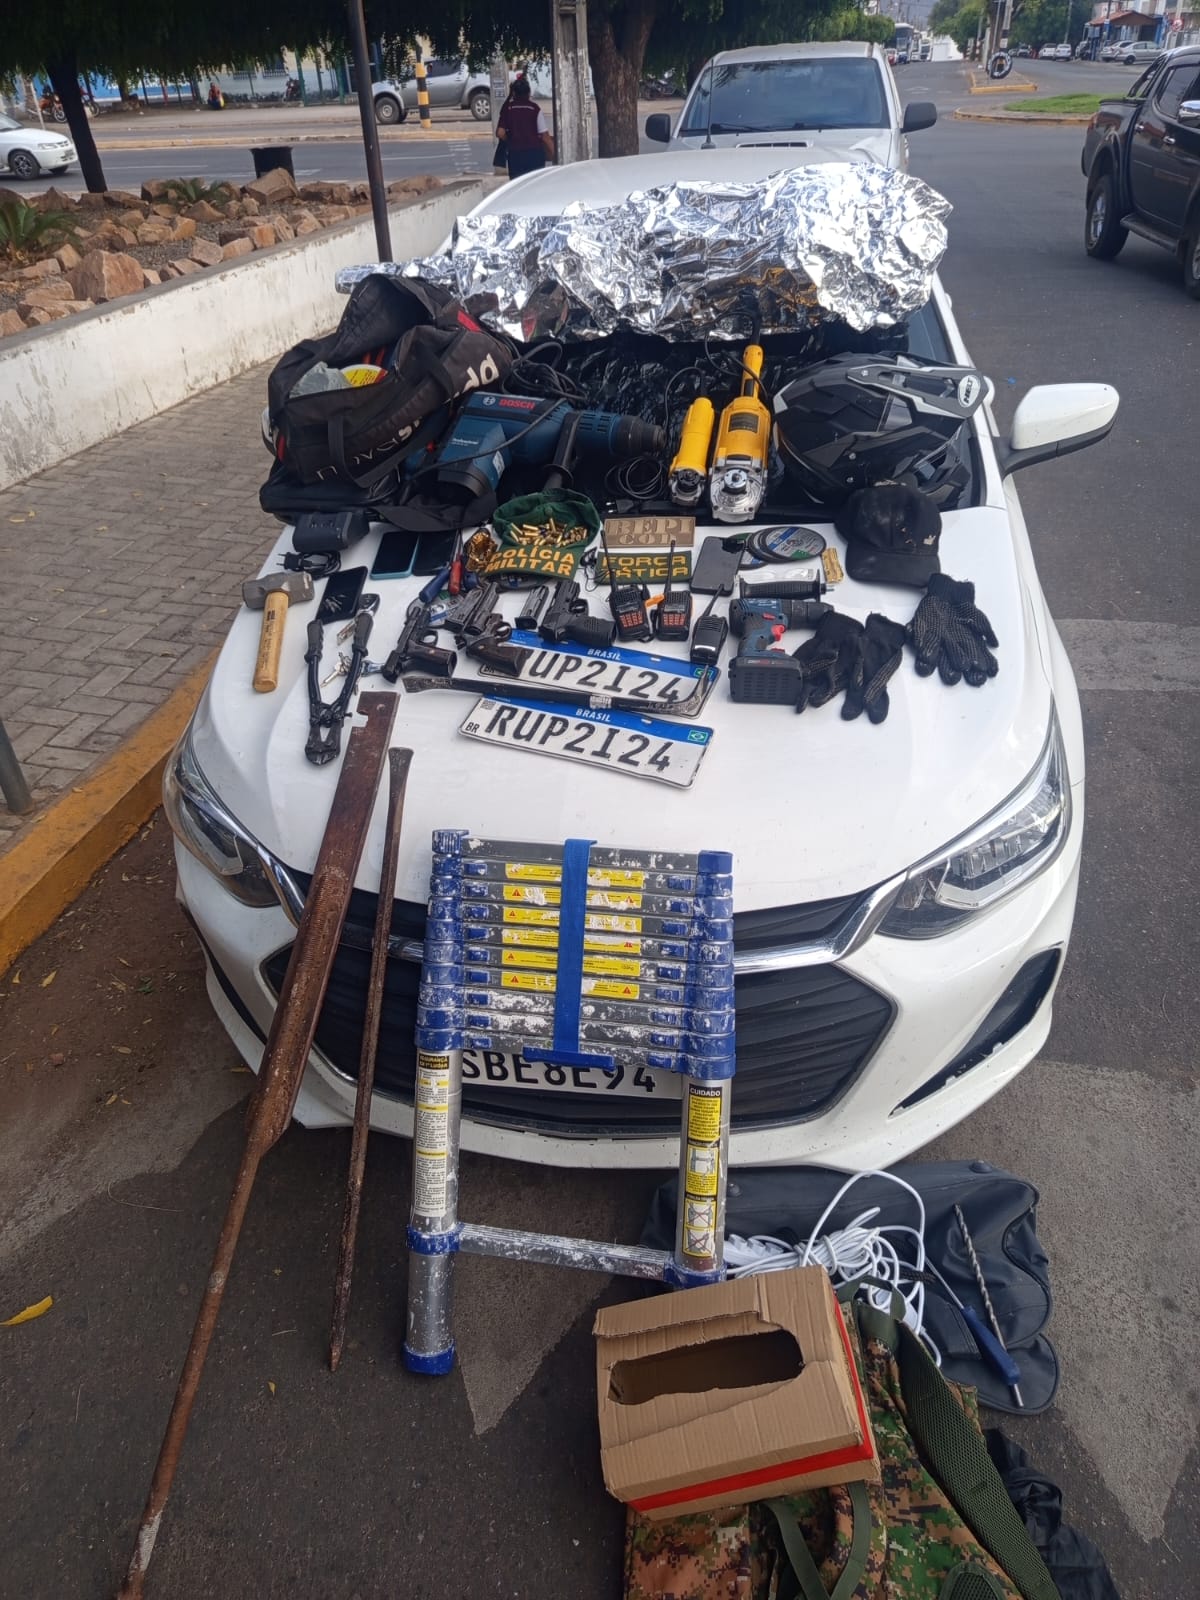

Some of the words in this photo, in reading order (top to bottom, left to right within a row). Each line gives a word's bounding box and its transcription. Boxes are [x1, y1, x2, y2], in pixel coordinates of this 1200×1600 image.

[498, 398, 536, 410] BOSCH
[489, 545, 575, 565] POLÍCIA
[484, 558, 573, 577] MILITAR
[587, 648, 622, 661] BRASIL
[520, 648, 683, 701] UP2I24
[576, 708, 611, 723] BRASIL
[464, 721, 480, 734] BR
[690, 1088, 720, 1097] CUIDADO
